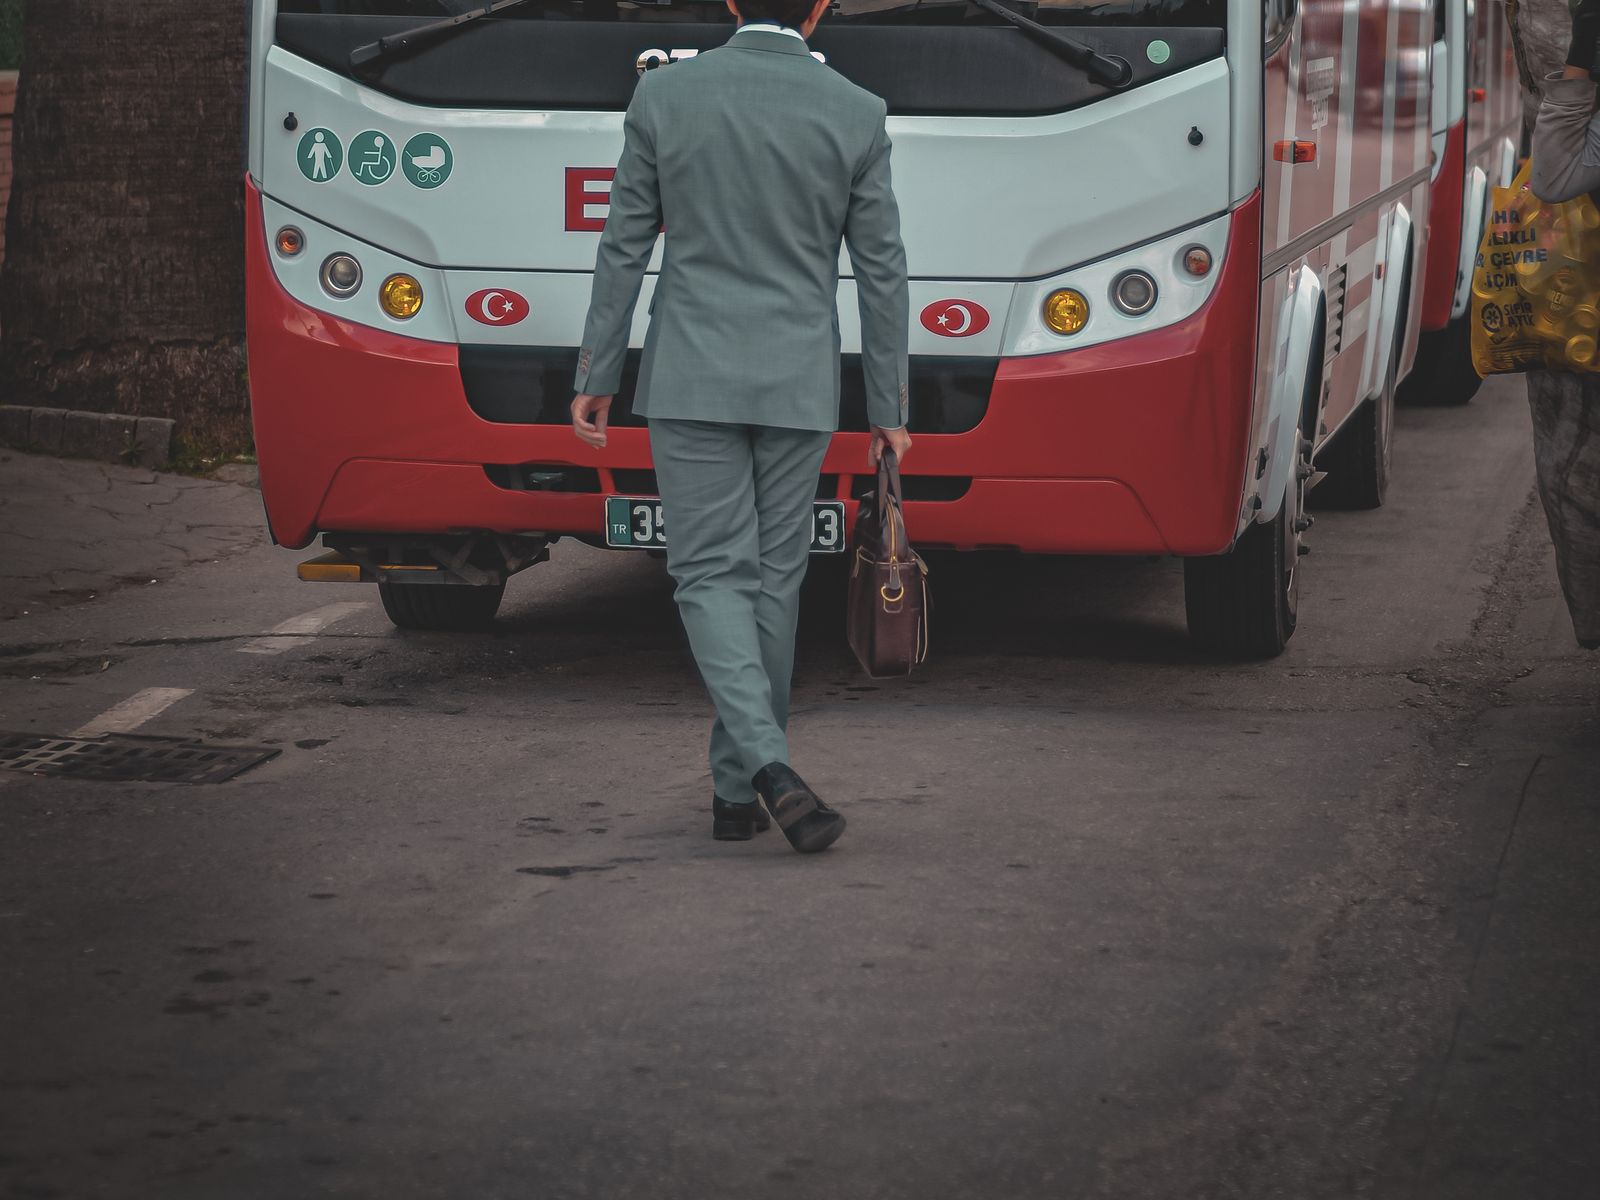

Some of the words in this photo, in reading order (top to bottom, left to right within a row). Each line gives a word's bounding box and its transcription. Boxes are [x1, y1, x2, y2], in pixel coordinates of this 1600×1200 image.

[1491, 210, 1521, 225] HA
[1487, 227, 1536, 246] LIKLI
[612, 523, 627, 534] TR
